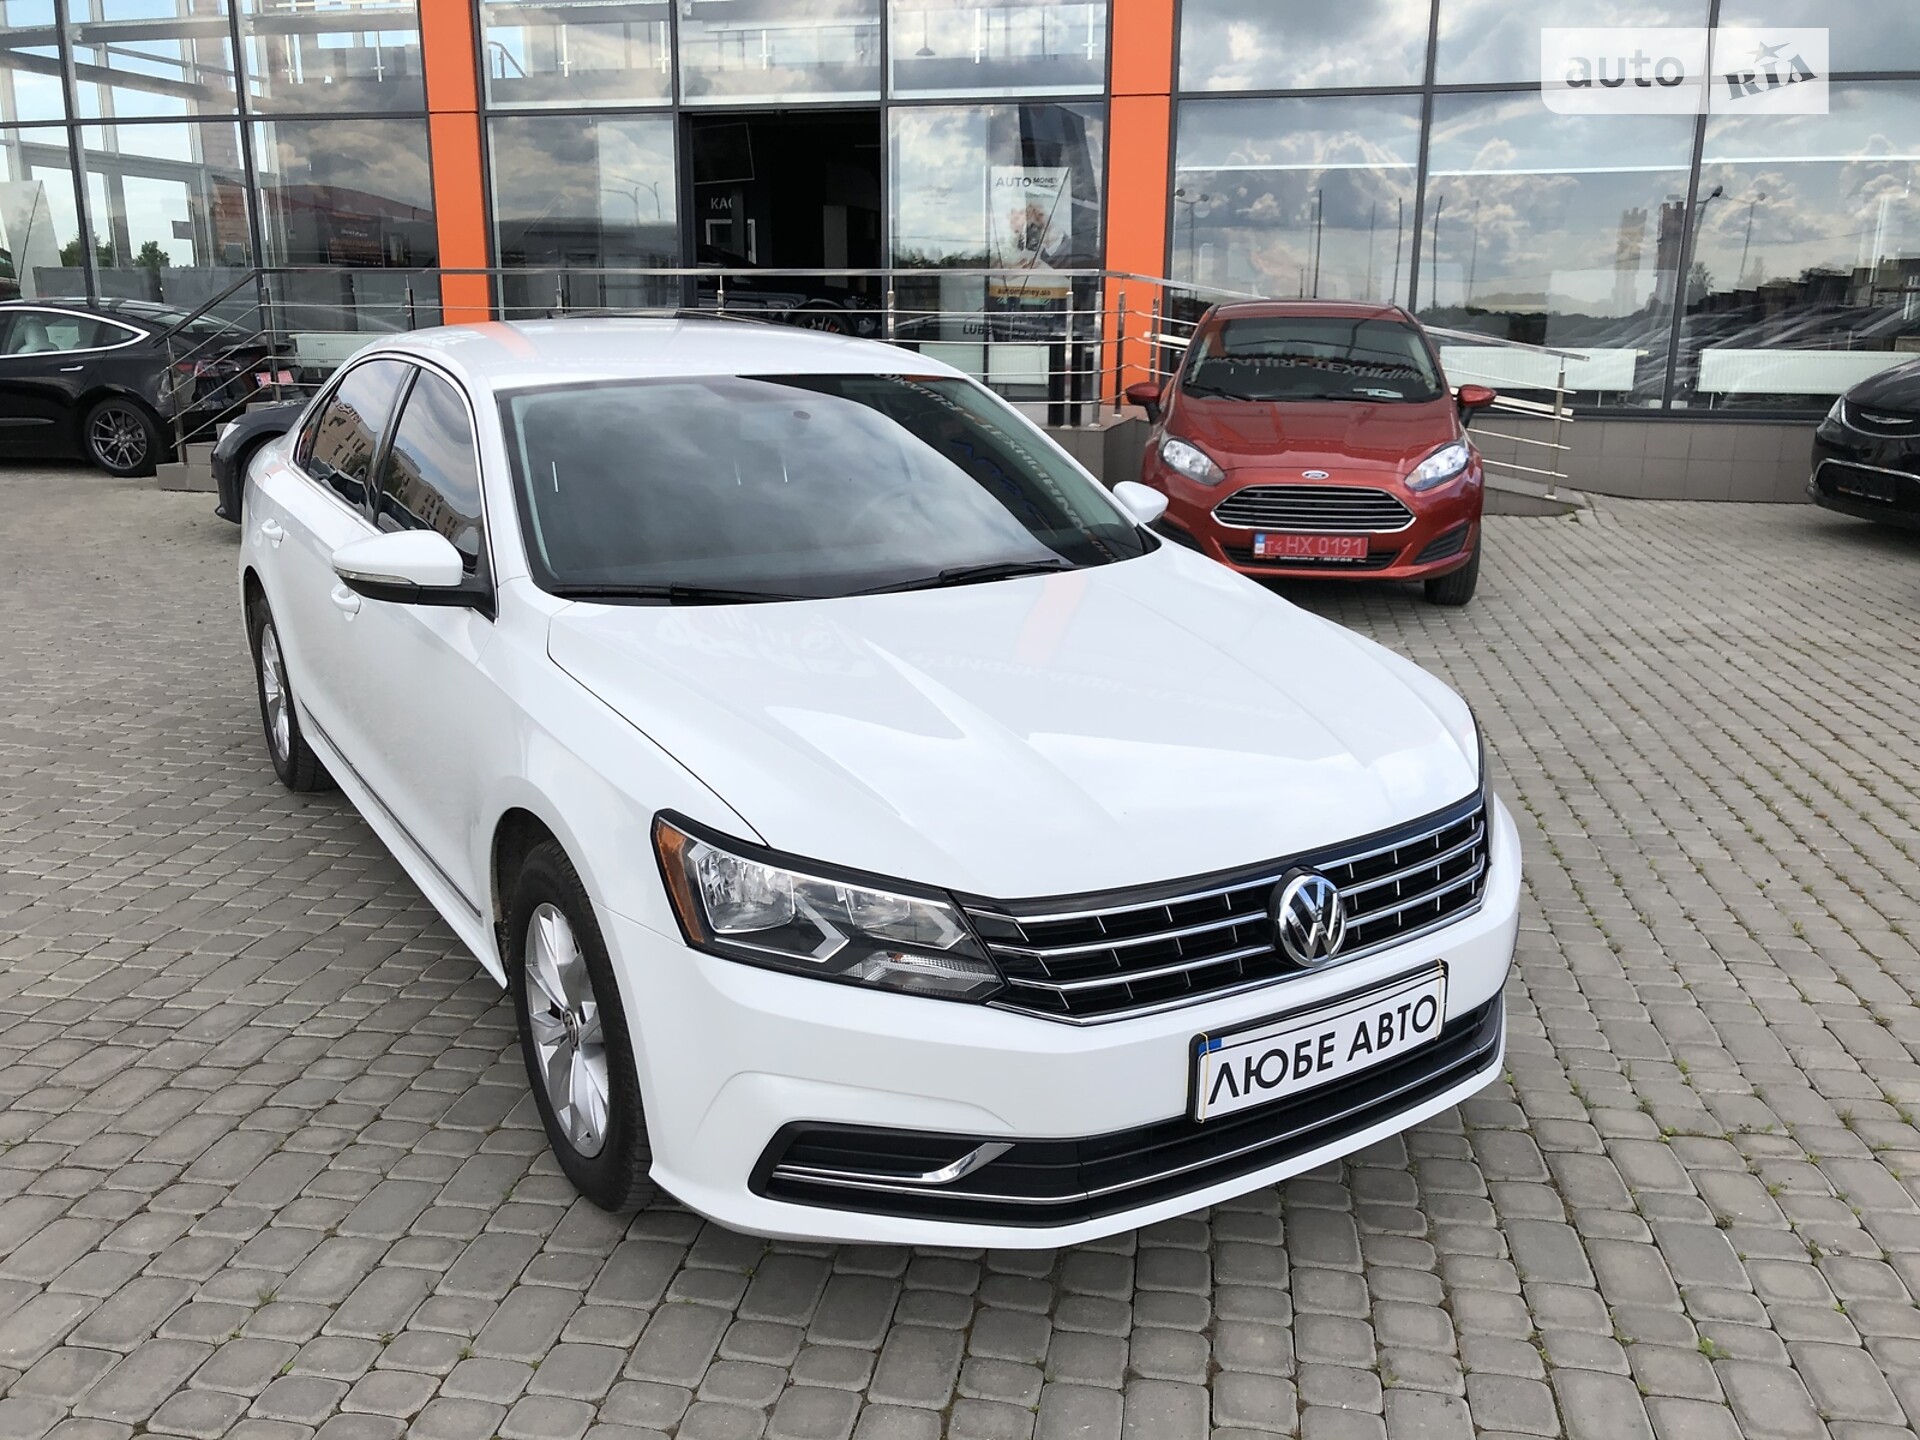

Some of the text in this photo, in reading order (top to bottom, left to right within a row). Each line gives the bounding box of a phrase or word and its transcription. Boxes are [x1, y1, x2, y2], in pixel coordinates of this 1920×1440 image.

[995, 177, 1031, 187] AUTO
[1318, 537, 1362, 555] 0191
[1208, 994, 1437, 1105] ЛЮБЕ АВТО
